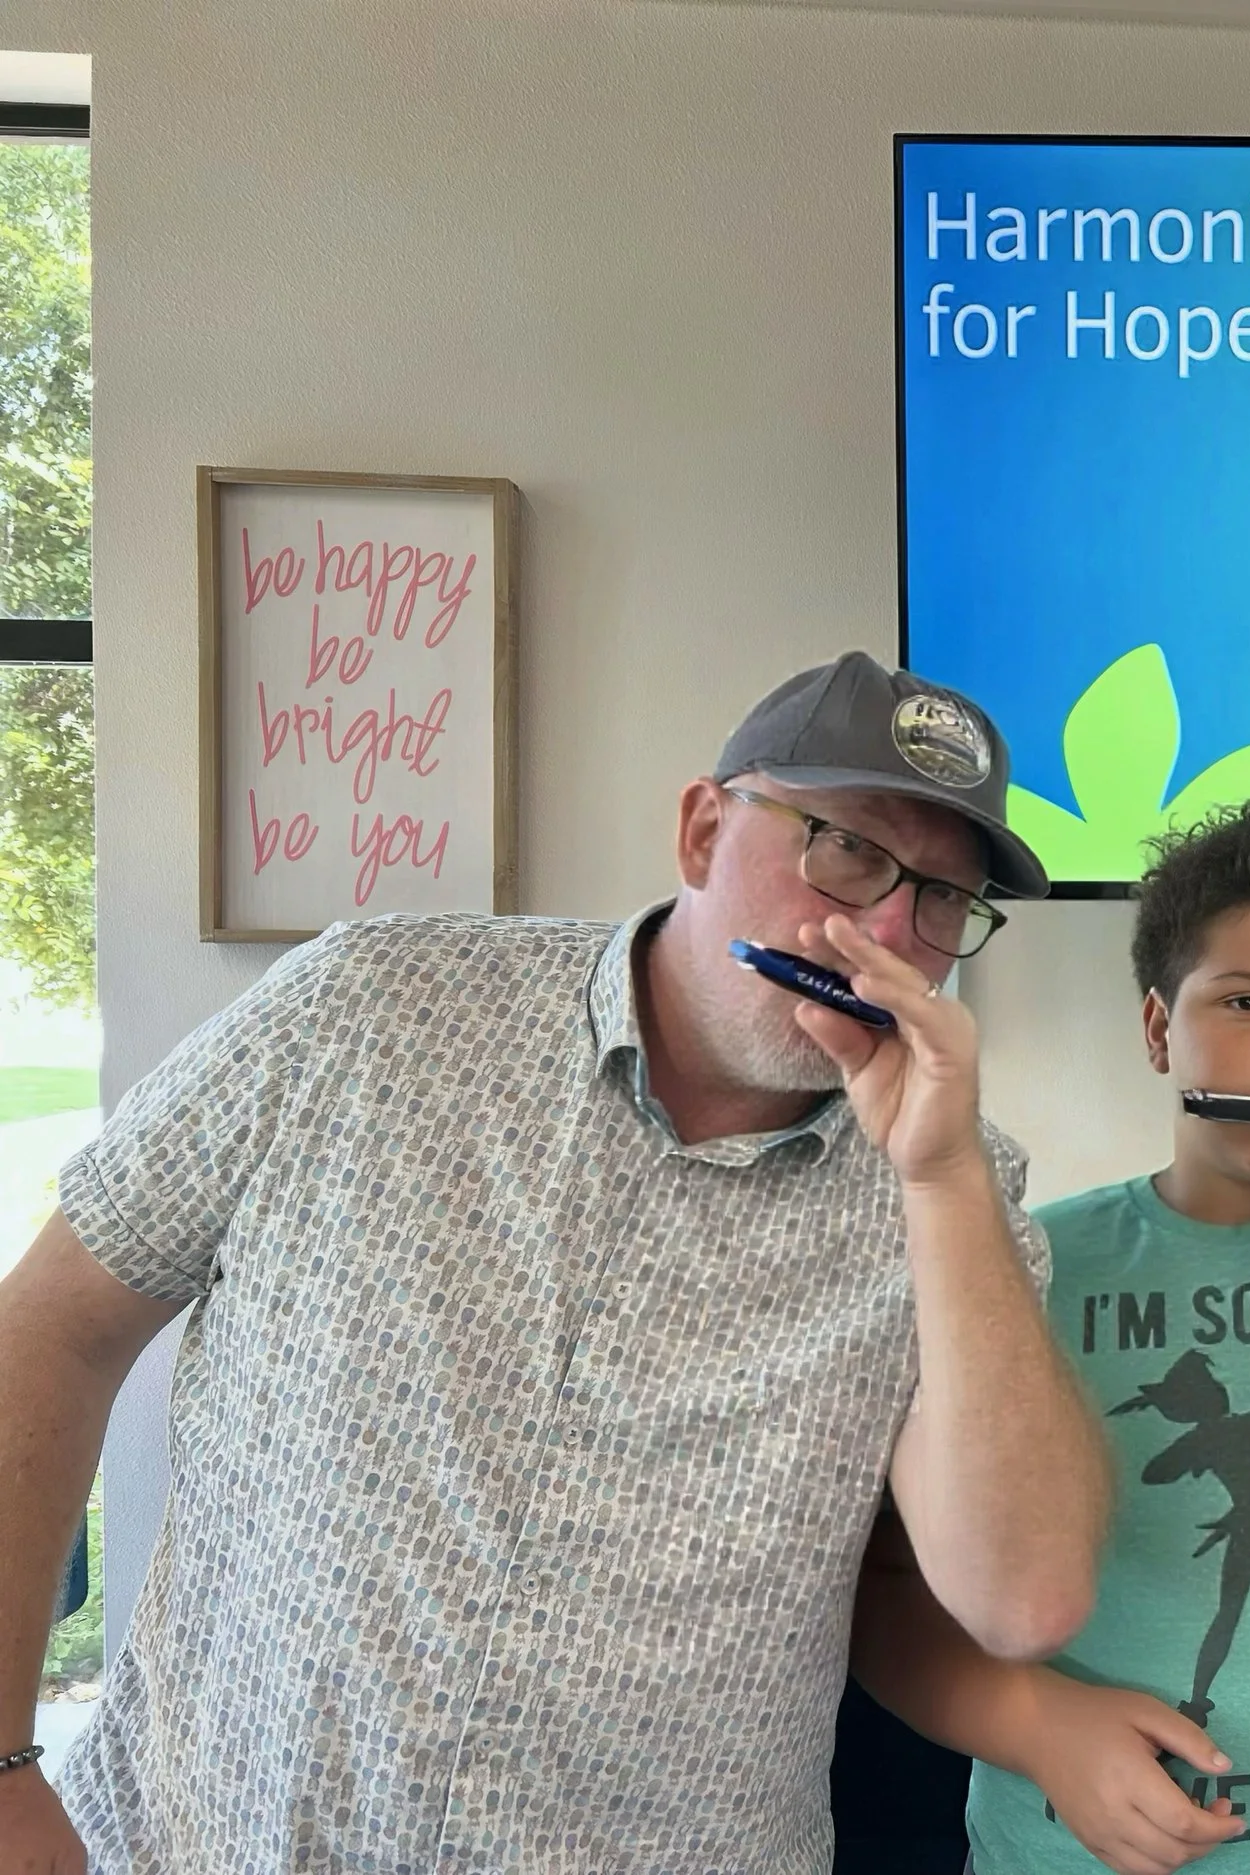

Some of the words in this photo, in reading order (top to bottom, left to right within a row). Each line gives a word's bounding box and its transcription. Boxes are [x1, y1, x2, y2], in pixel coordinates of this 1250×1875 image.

[923, 282, 1037, 359] for
[242, 527, 305, 614] be
[315, 519, 477, 648] happy
[305, 603, 374, 689] be
[258, 681, 452, 805] bright
[249, 788, 319, 875] be
[351, 812, 450, 907] you
[1082, 1290, 1167, 1354] I'M
